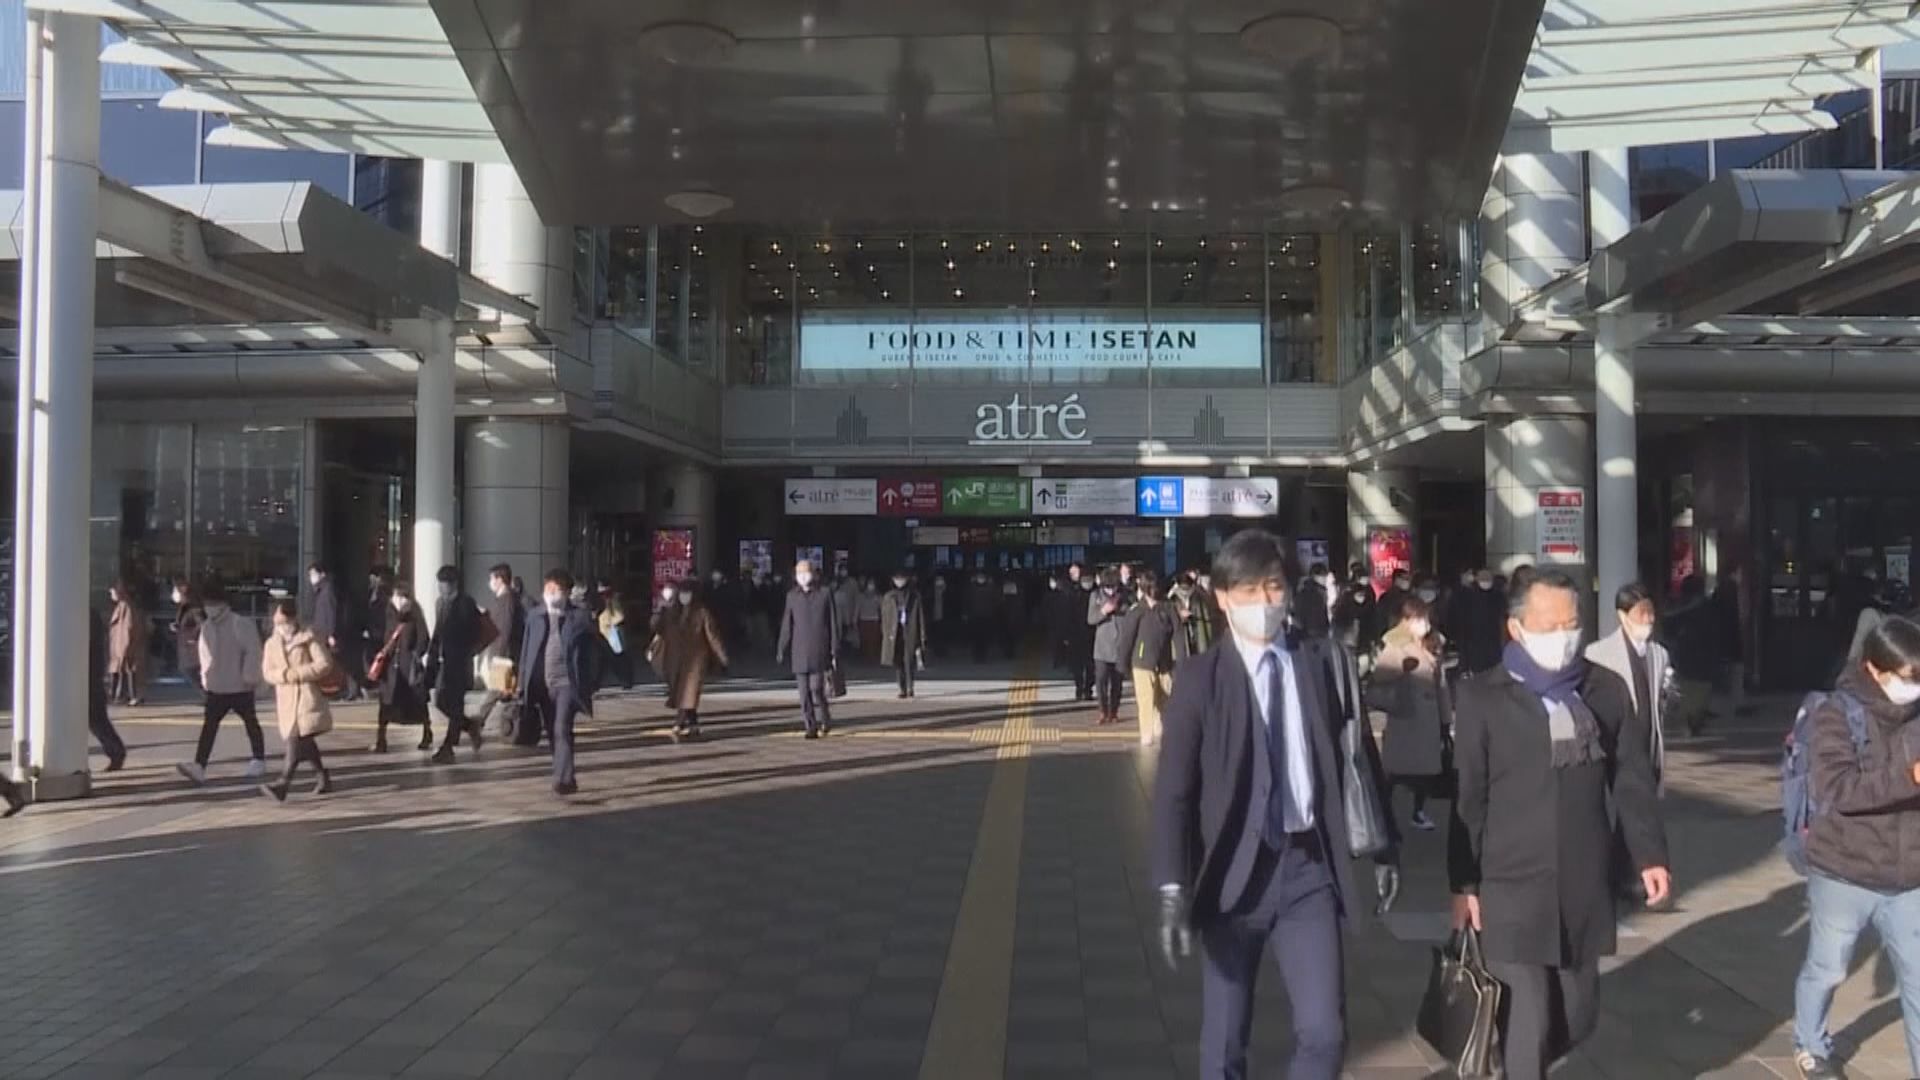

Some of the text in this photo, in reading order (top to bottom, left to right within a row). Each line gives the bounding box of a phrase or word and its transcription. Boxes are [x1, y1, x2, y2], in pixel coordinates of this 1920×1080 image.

[868, 330, 1197, 349] FOOD & TIME ISETAN
[975, 393, 1087, 440] atré
[965, 482, 985, 497] JR
